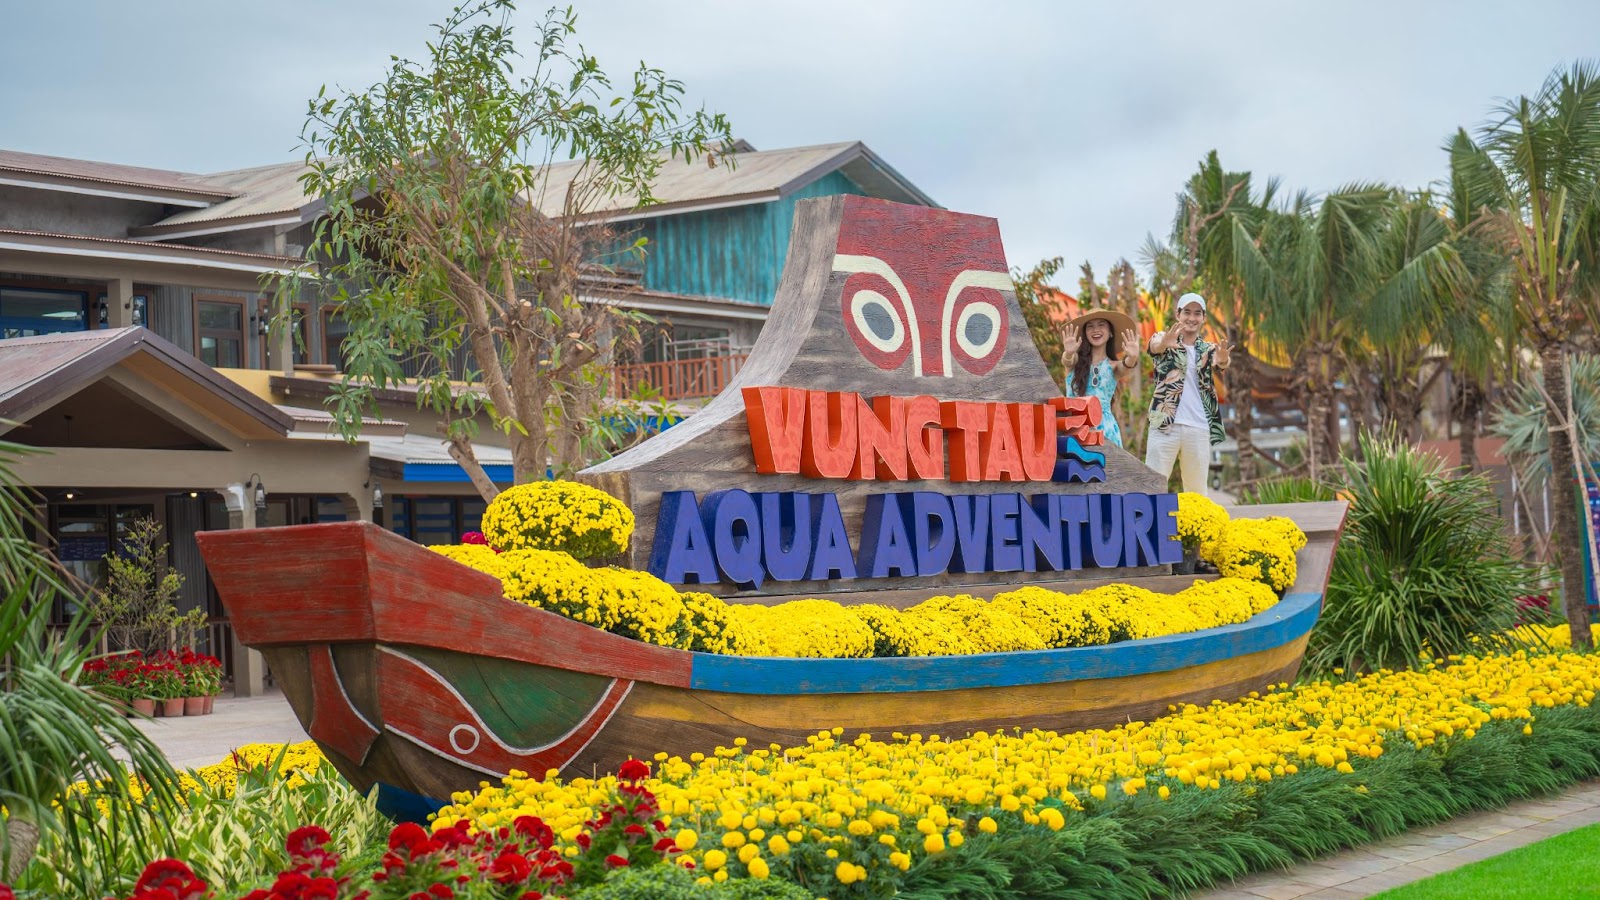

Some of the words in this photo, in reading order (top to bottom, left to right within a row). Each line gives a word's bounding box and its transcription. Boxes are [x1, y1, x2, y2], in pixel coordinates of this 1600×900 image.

[742, 386, 944, 481] VUNG
[948, 401, 1057, 482] TAU
[650, 489, 858, 590] AQUA
[860, 491, 1183, 578] ADVENTURE
